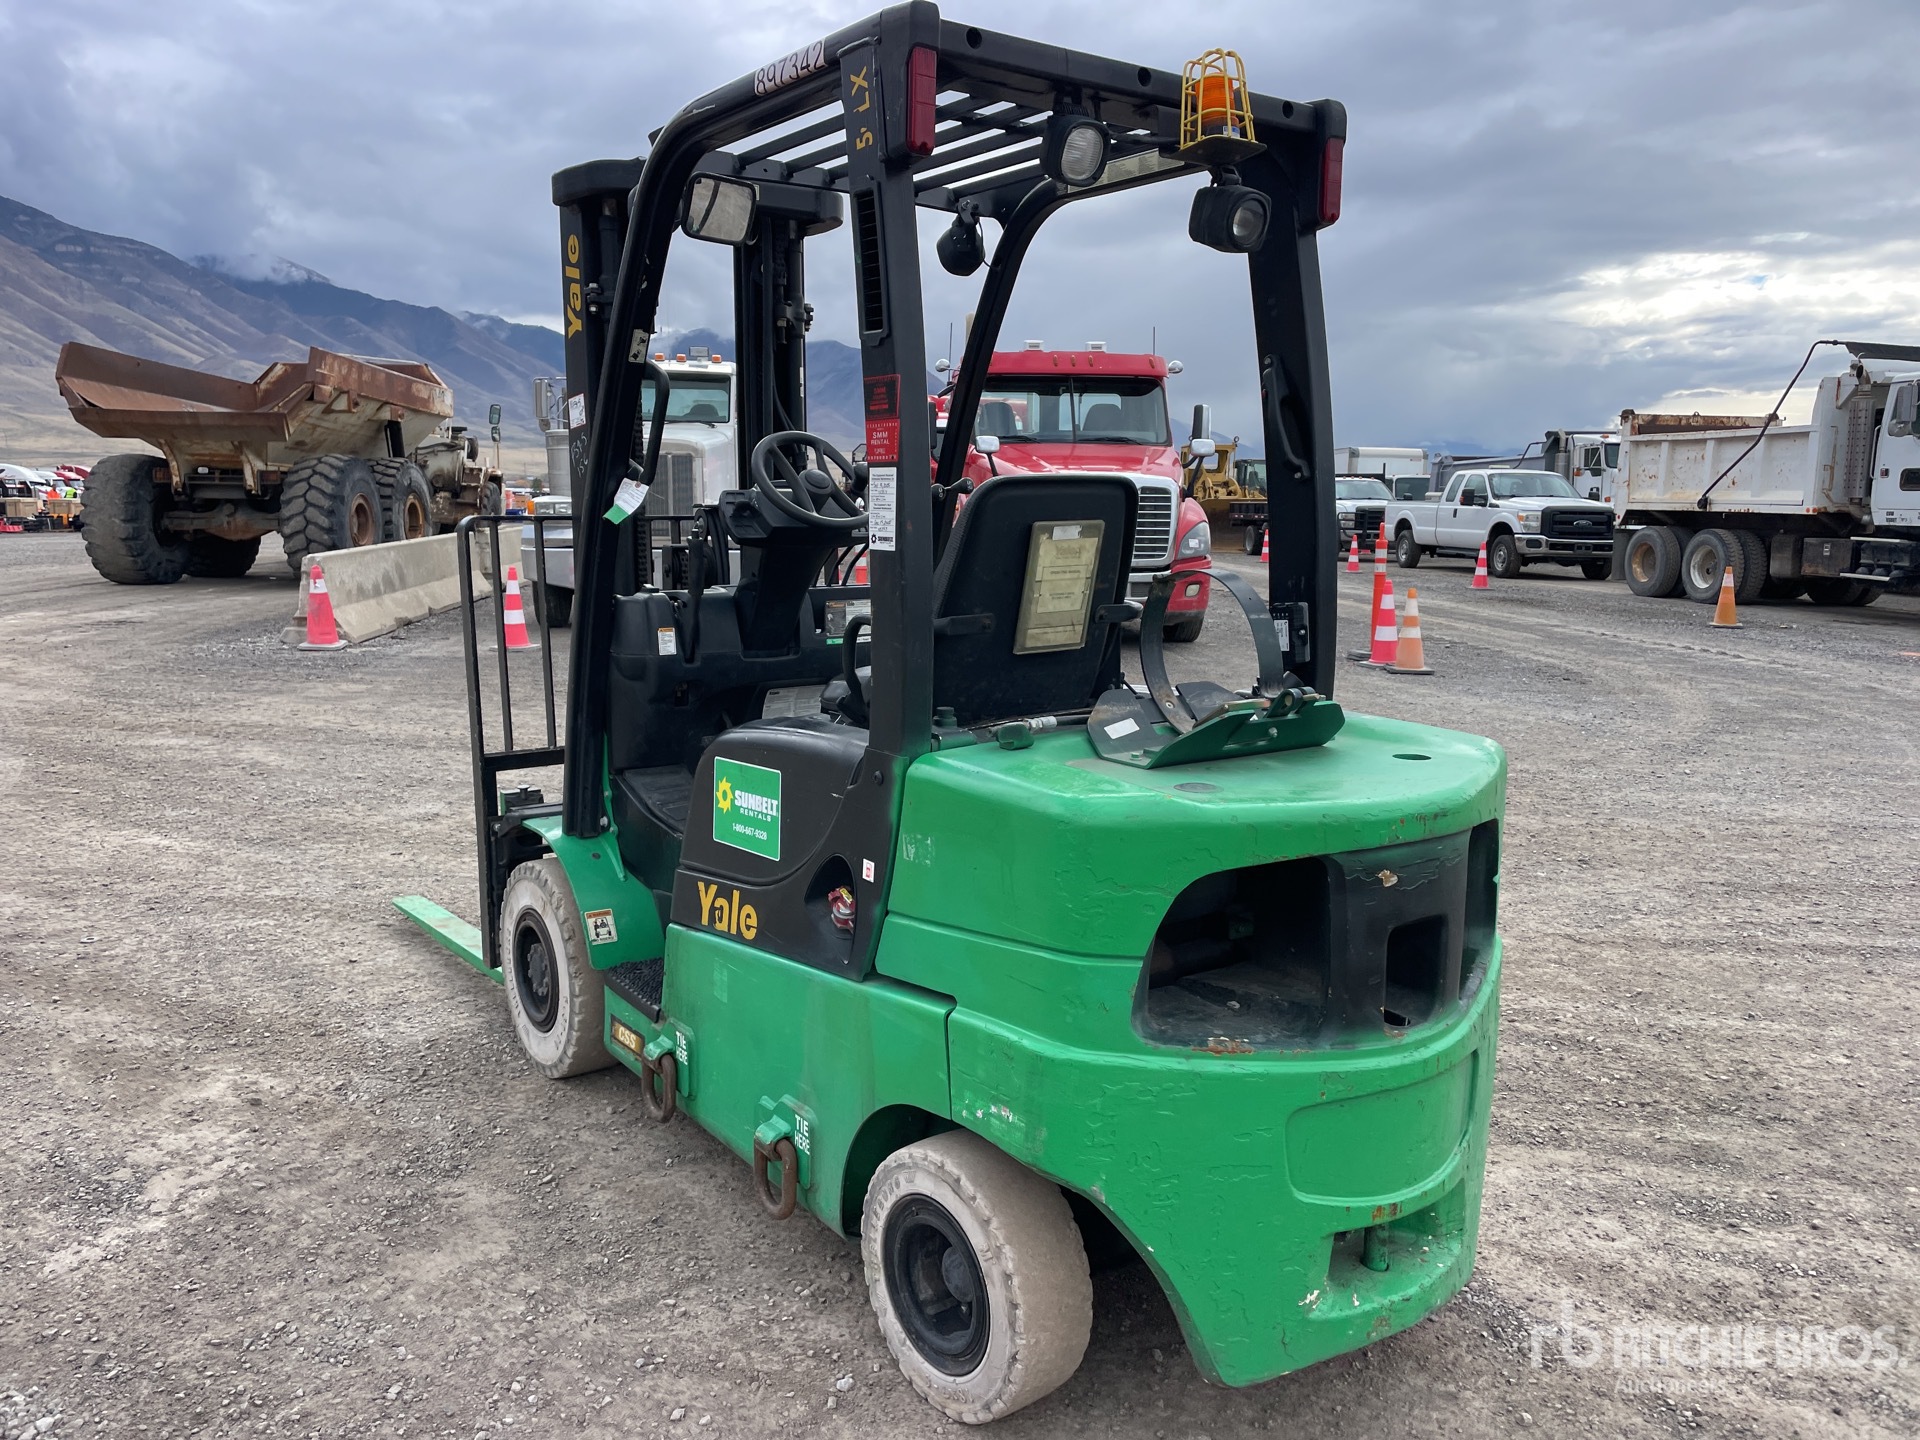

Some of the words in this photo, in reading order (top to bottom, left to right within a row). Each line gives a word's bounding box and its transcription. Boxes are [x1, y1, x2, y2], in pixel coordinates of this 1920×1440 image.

[755, 40, 826, 95] 897342
[565, 234, 583, 339] Yale
[870, 438, 890, 446] RENTAL
[872, 431, 889, 439] SMM
[734, 789, 779, 817] SUNBELT
[739, 807, 772, 822] RENTALS
[697, 880, 758, 940] Yale
[618, 1026, 637, 1049] CSS
[675, 1030, 687, 1050] TIE
[794, 1113, 809, 1137] TIE
[794, 1129, 810, 1156] HERE
